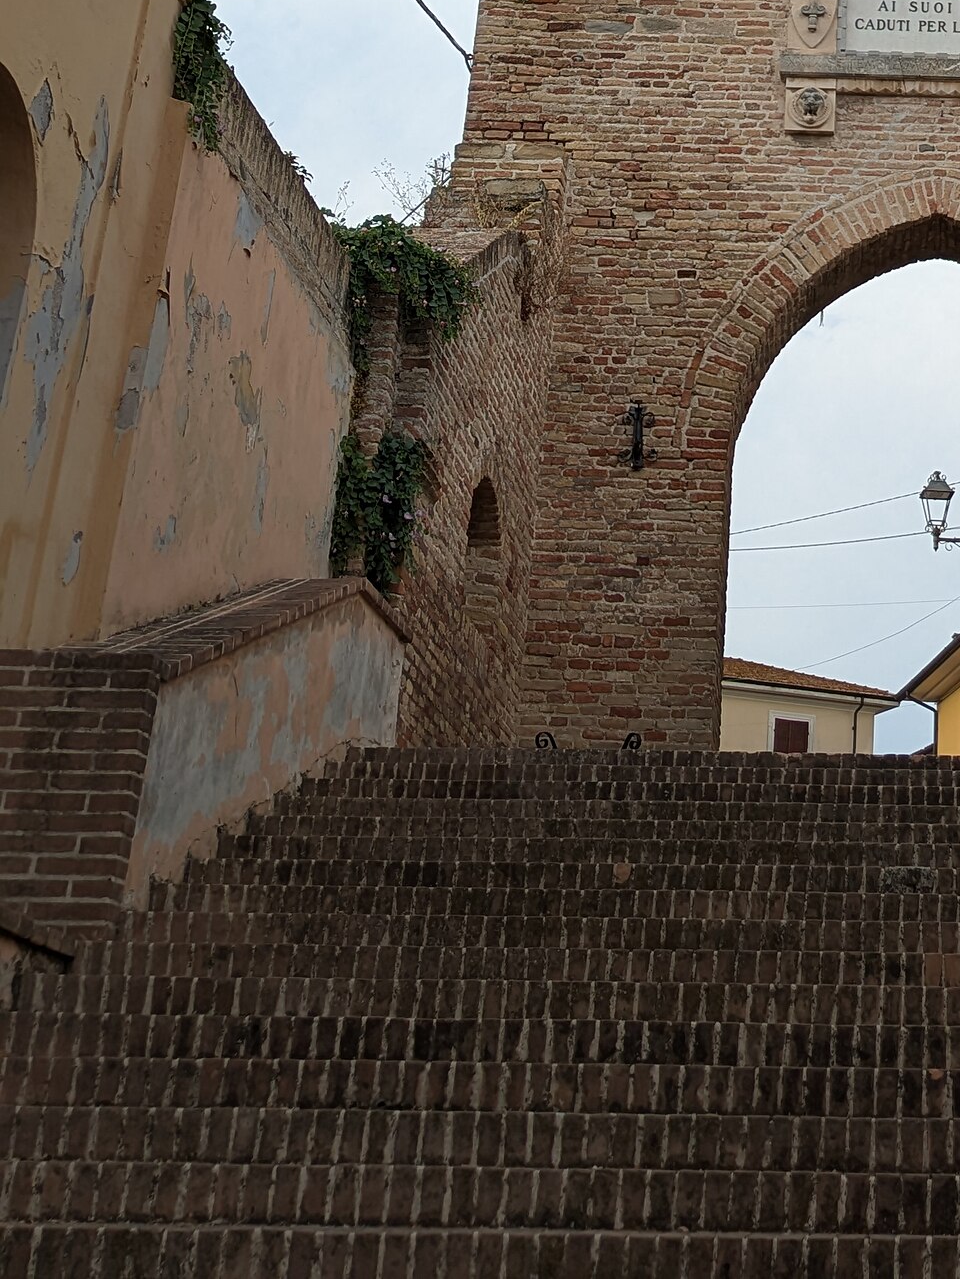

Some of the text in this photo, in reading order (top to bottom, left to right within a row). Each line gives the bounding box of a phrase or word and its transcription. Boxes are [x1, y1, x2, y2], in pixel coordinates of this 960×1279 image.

[877, 1, 896, 12] AI
[908, 1, 952, 14] SUOI
[854, 18, 910, 31] CADUTI
[918, 20, 948, 33] PER
